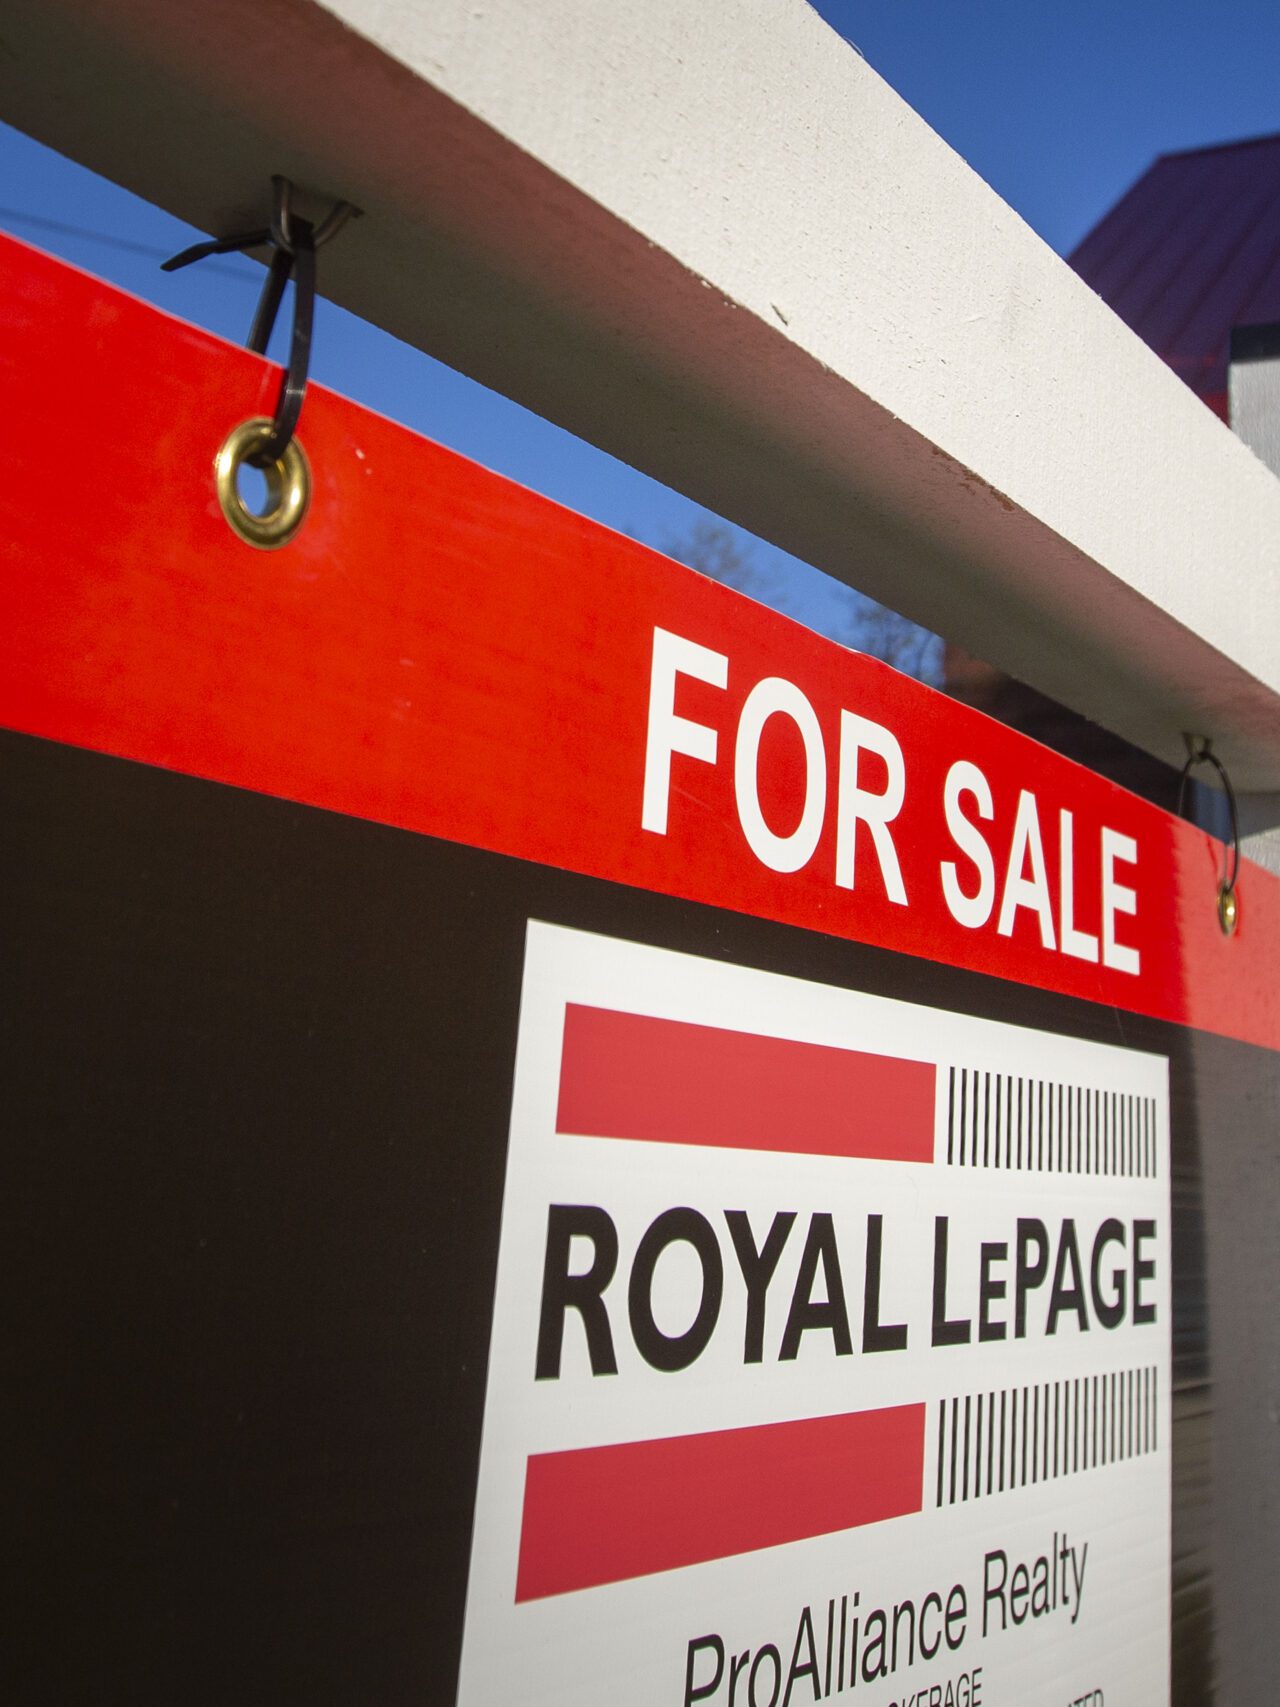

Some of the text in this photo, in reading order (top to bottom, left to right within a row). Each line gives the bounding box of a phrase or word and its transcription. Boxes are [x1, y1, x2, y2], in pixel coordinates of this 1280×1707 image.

[641, 625, 1141, 977] FOR SALE
[533, 1203, 908, 1382] ROYAL
[683, 1531, 1089, 1707] ProAlliance Realty
